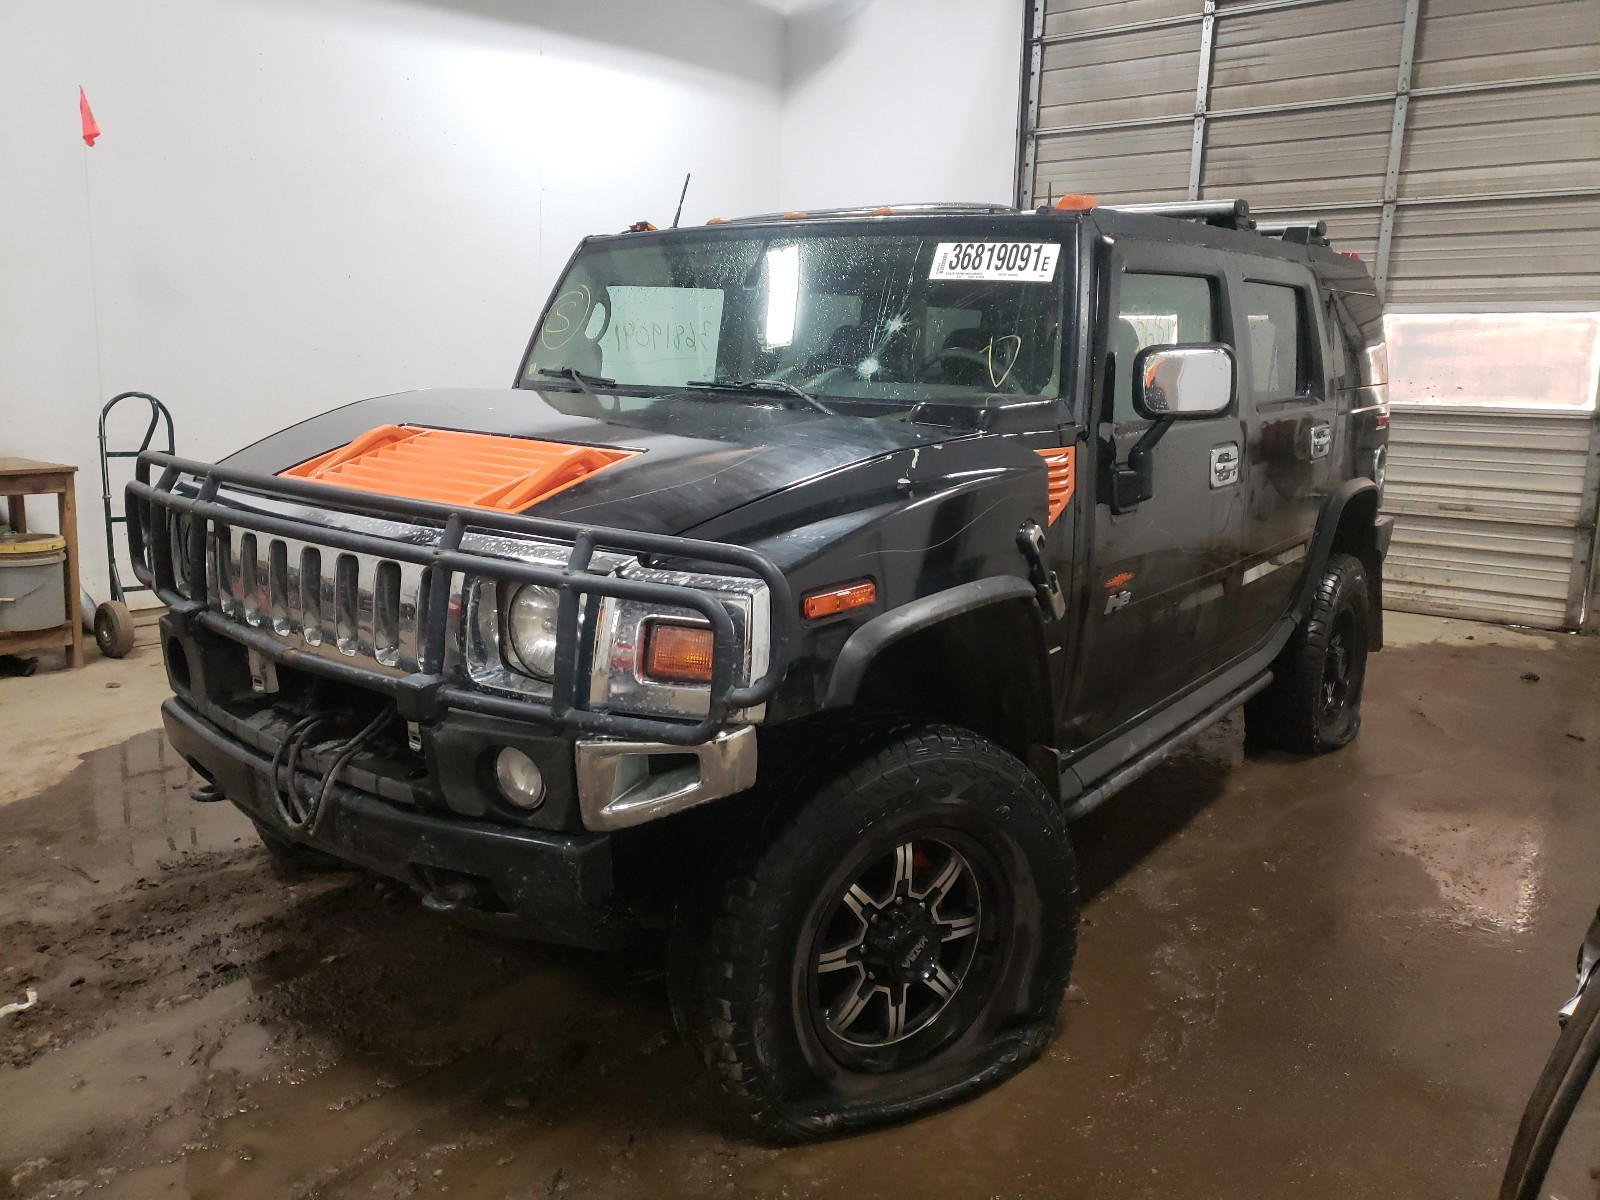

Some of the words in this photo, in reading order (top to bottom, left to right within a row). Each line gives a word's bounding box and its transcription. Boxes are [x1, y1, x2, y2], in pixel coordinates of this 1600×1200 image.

[948, 243, 1043, 272] 36819091
[1041, 256, 1051, 272] E
[1103, 590, 1132, 615] H2
